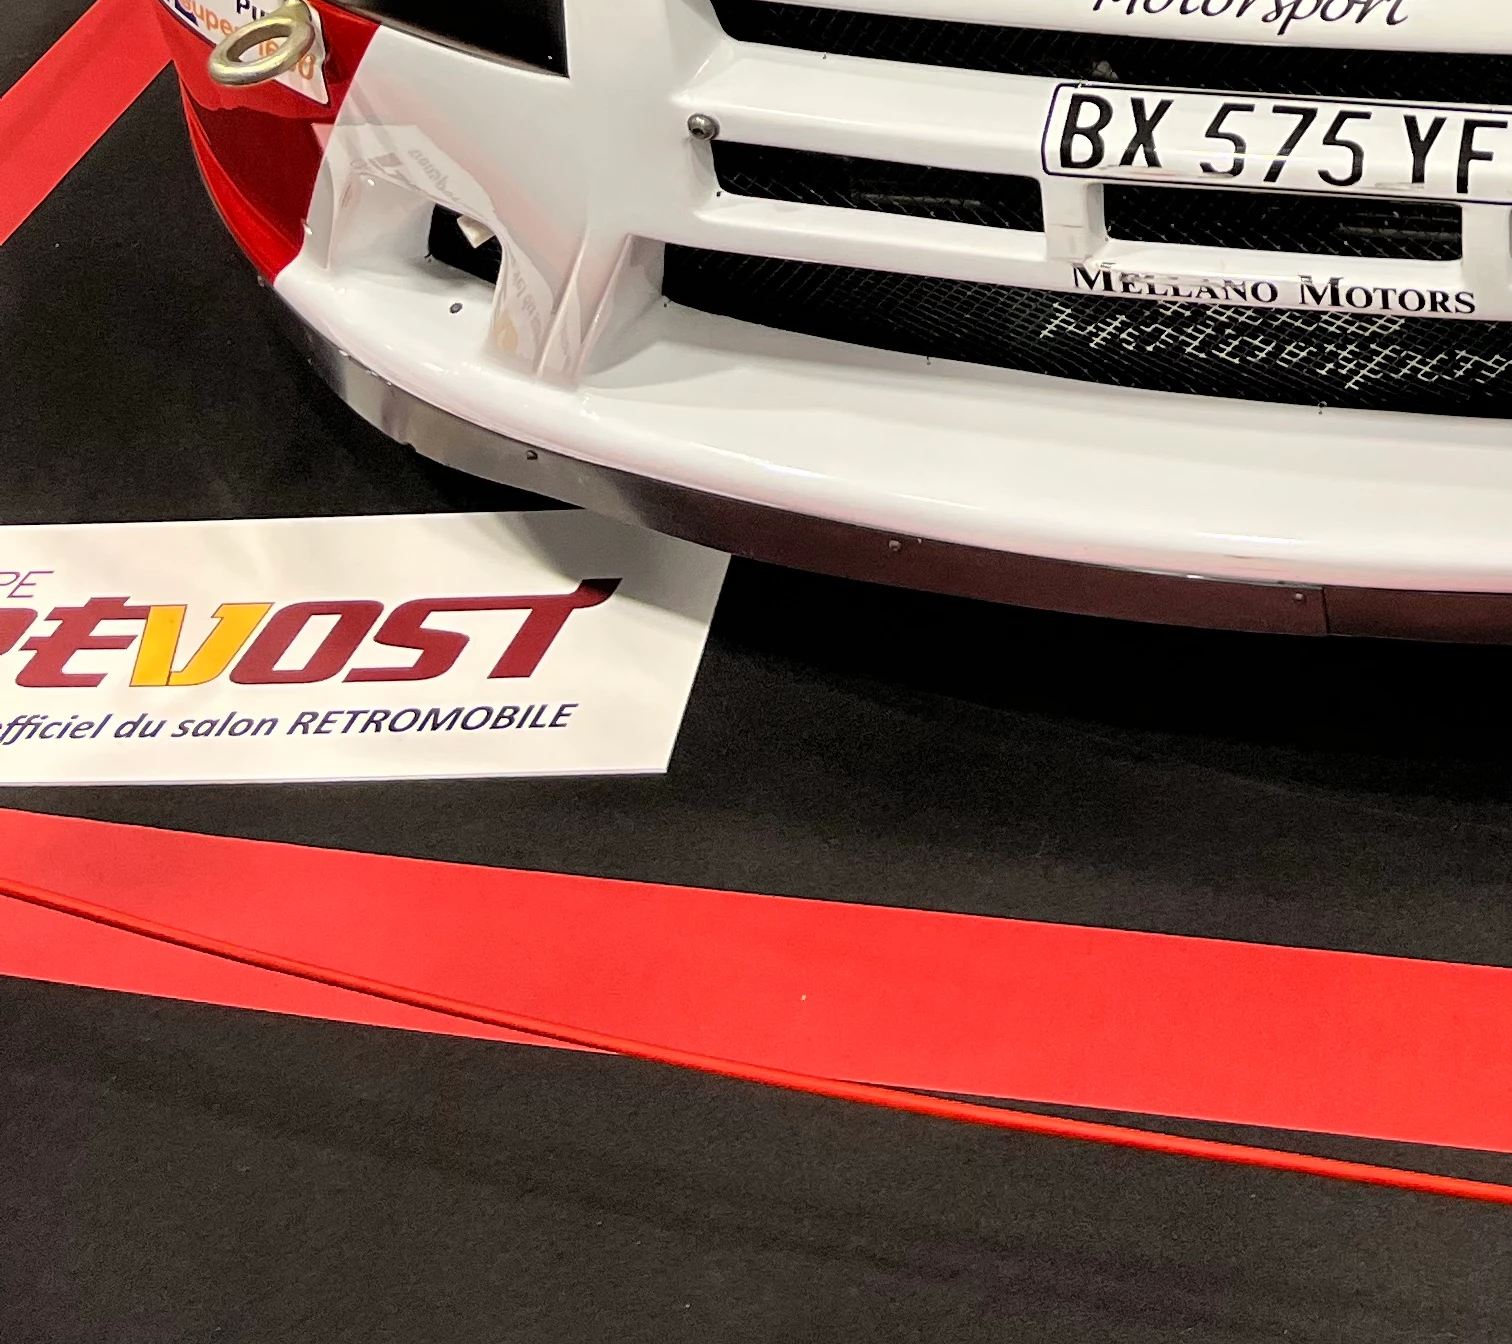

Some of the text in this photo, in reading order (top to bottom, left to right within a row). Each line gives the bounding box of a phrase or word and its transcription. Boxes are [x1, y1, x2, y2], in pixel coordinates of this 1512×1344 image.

[1058, 93, 1509, 195] BX 575 YF
[1073, 263, 1477, 315] MELLANO MOTORS
[0, 702, 579, 746] fficiel du salon RETROMOBILE
